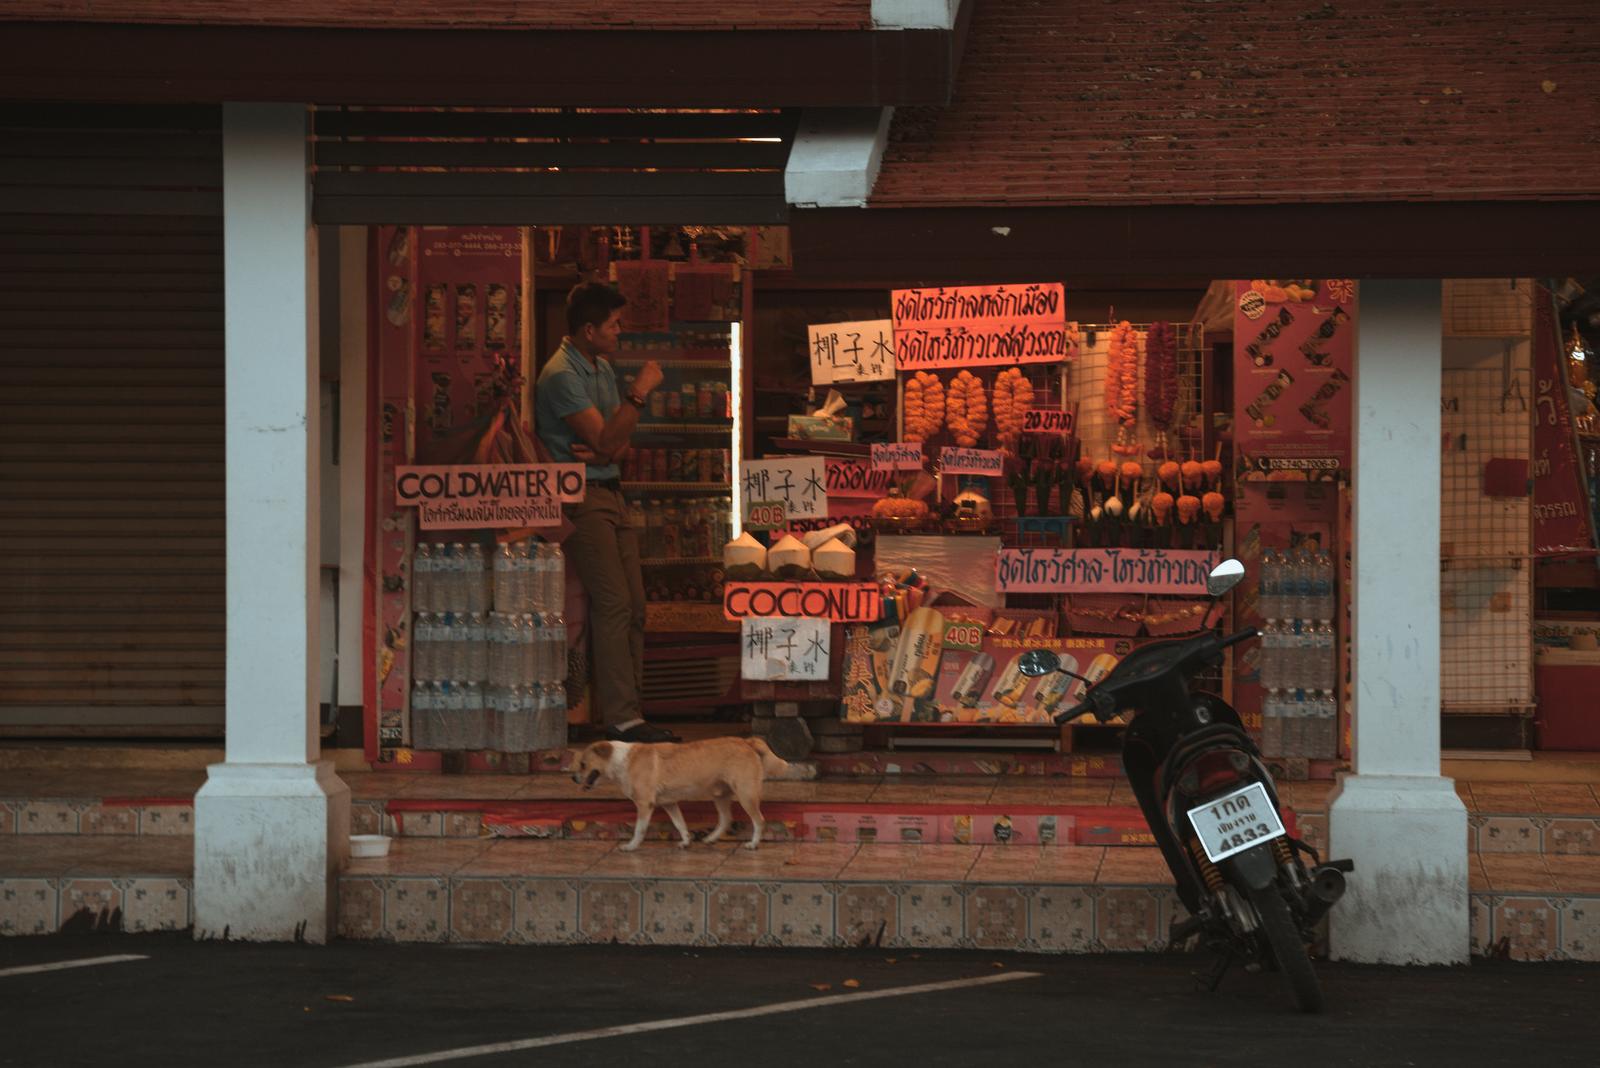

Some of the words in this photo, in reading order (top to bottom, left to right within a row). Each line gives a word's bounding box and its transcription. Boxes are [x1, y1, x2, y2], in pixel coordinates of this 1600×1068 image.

[812, 331, 895, 366] 椰子水
[1024, 411, 1042, 430] 20
[743, 468, 826, 503] 椰子水
[727, 588, 877, 617] COCONUT
[747, 624, 829, 662] 椰子水
[1220, 823, 1270, 852] 4833
